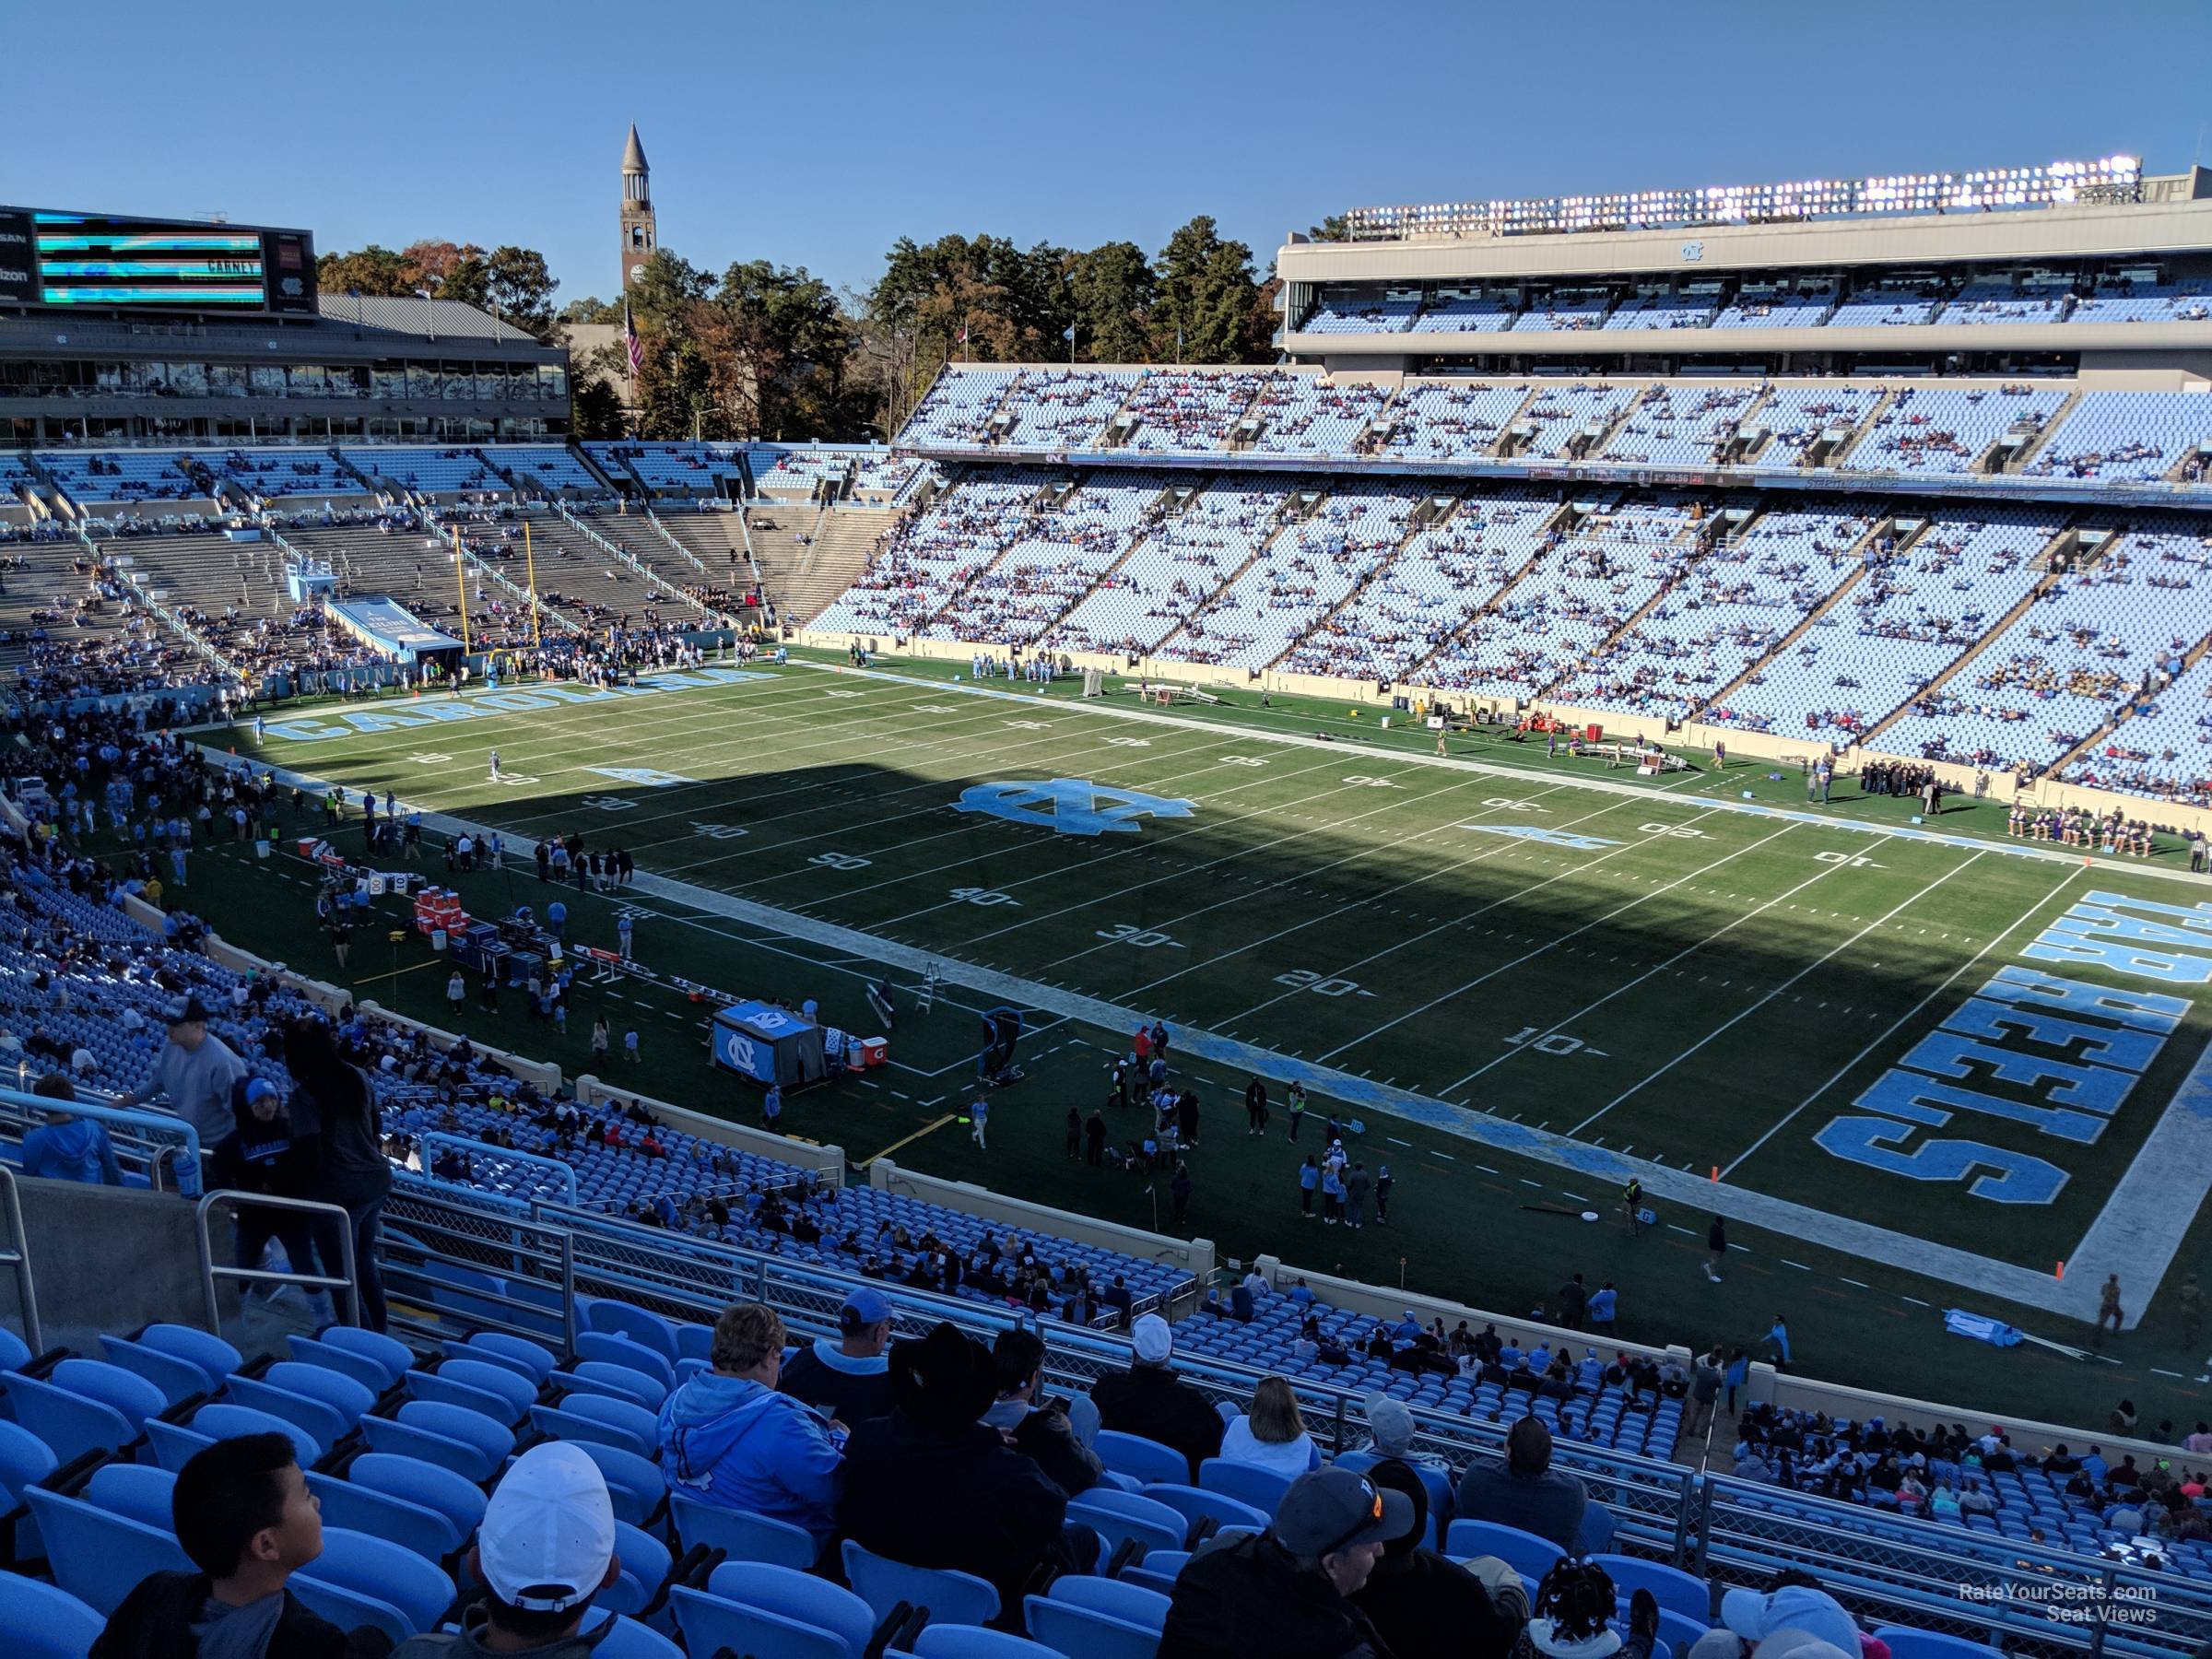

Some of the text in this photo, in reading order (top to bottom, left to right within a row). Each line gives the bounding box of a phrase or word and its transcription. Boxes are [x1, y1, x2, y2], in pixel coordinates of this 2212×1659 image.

[208, 261, 254, 274] CARNEY
[1404, 465, 1444, 474] STARTING
[1638, 472, 1645, 482] 0
[1638, 823, 1704, 839] 20
[807, 853, 873, 870] 50
[1813, 852, 1873, 867] 10
[948, 887, 1012, 906] 40
[1095, 924, 1171, 947] 30
[1272, 970, 1359, 996] 20
[1502, 1027, 1585, 1055] 10
[1812, 964, 2194, 1205] HEELS
